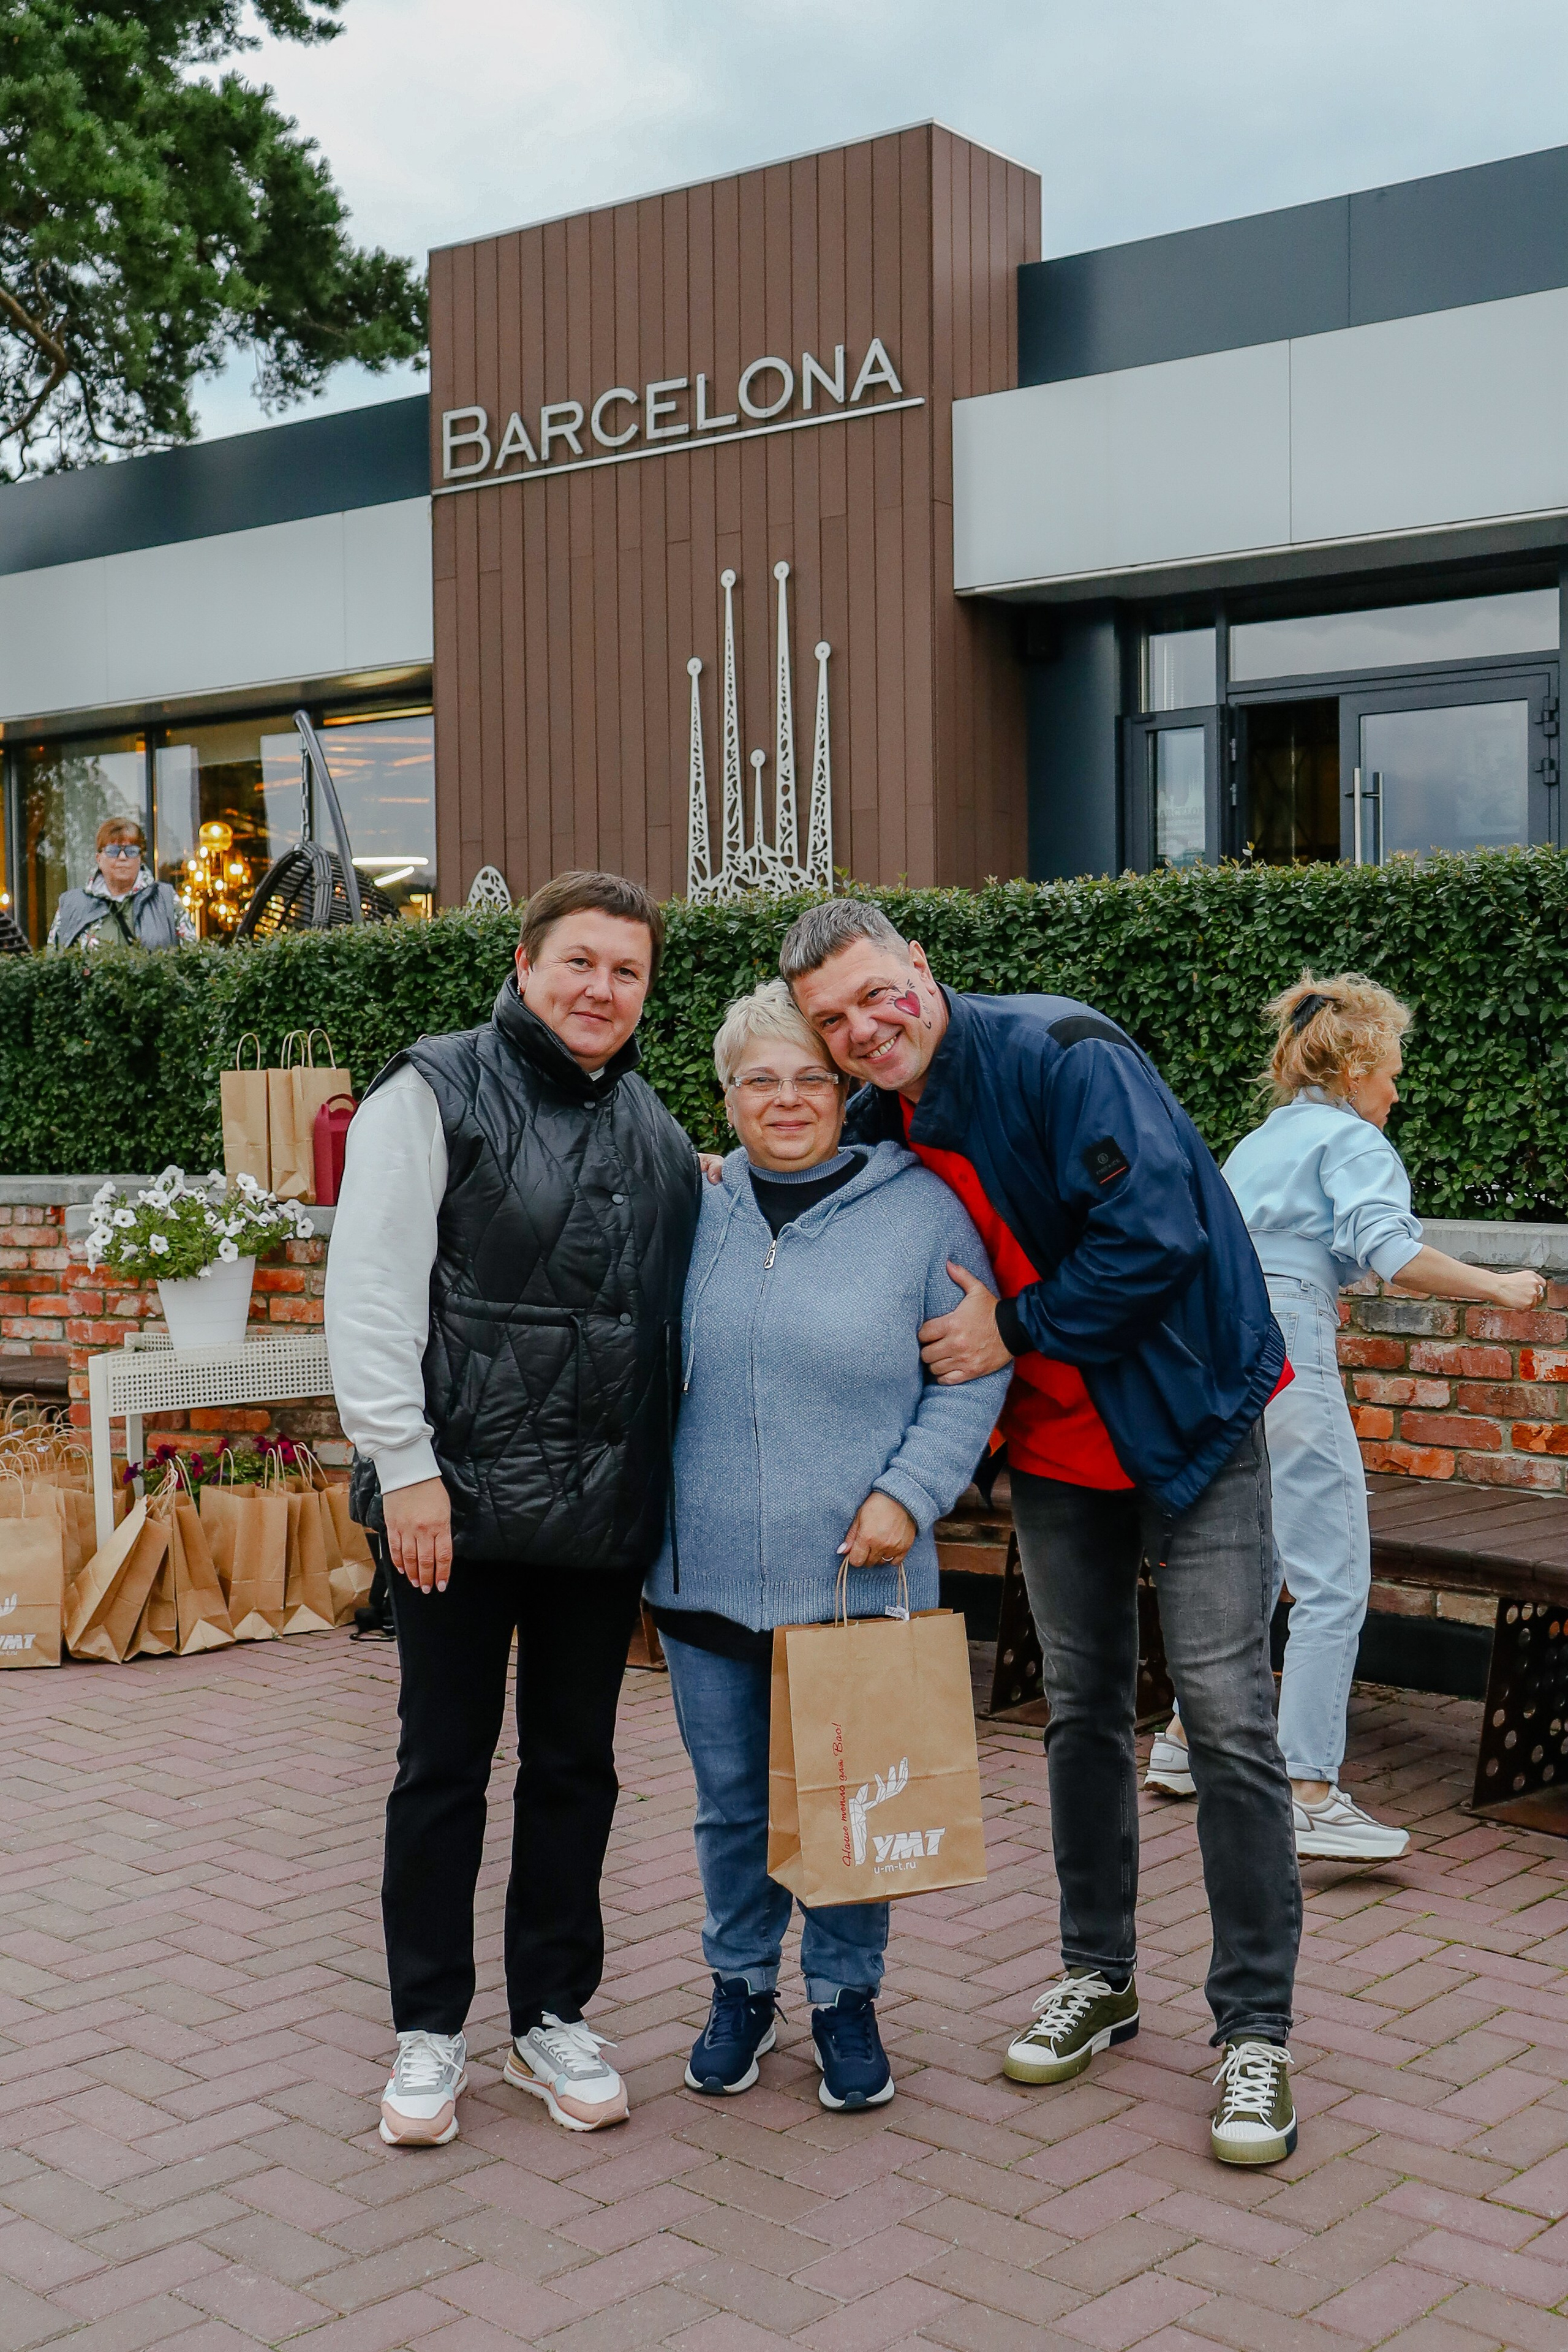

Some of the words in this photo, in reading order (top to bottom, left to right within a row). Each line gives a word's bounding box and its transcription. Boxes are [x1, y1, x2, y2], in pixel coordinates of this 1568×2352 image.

[442, 336, 903, 480] BARCELONA
[832, 1722, 843, 1756] Вас!
[839, 1759, 848, 1781] для
[841, 1825, 851, 1867] Наше
[872, 1826, 946, 1863] УМТ
[873, 1861, 916, 1874] u-m-t.ru
